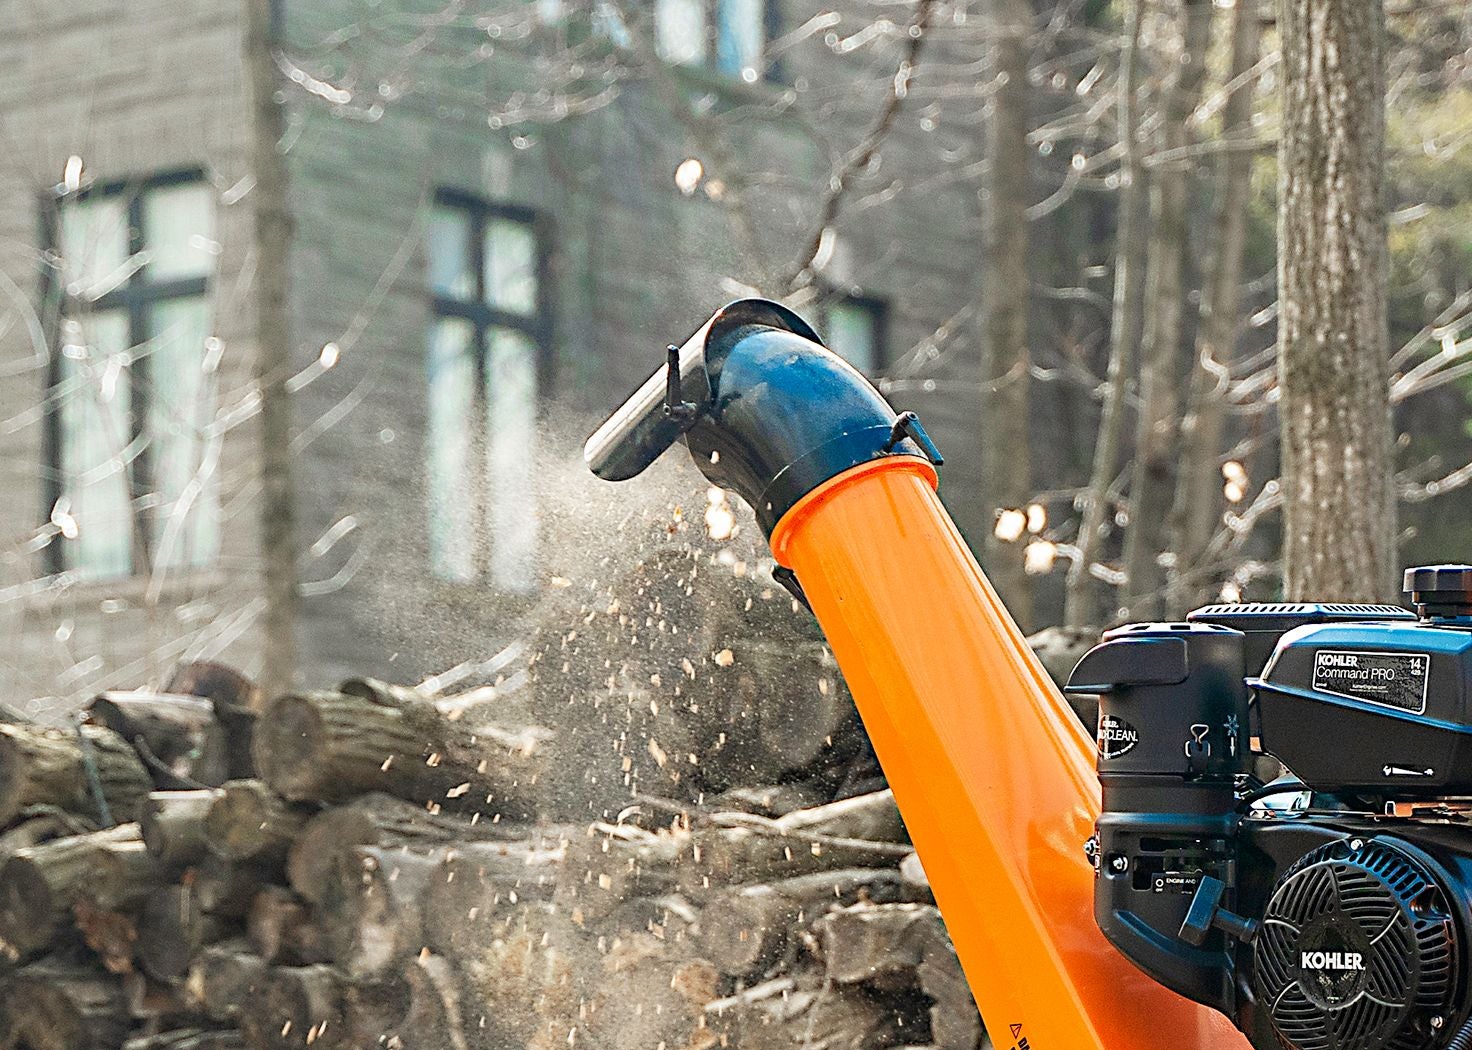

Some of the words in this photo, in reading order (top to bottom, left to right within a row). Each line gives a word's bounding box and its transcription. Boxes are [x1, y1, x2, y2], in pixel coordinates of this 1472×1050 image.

[1318, 654, 1358, 668] KOHLER
[1409, 658, 1421, 670] 14
[1316, 666, 1369, 680] Command
[1370, 668, 1395, 681] PRO
